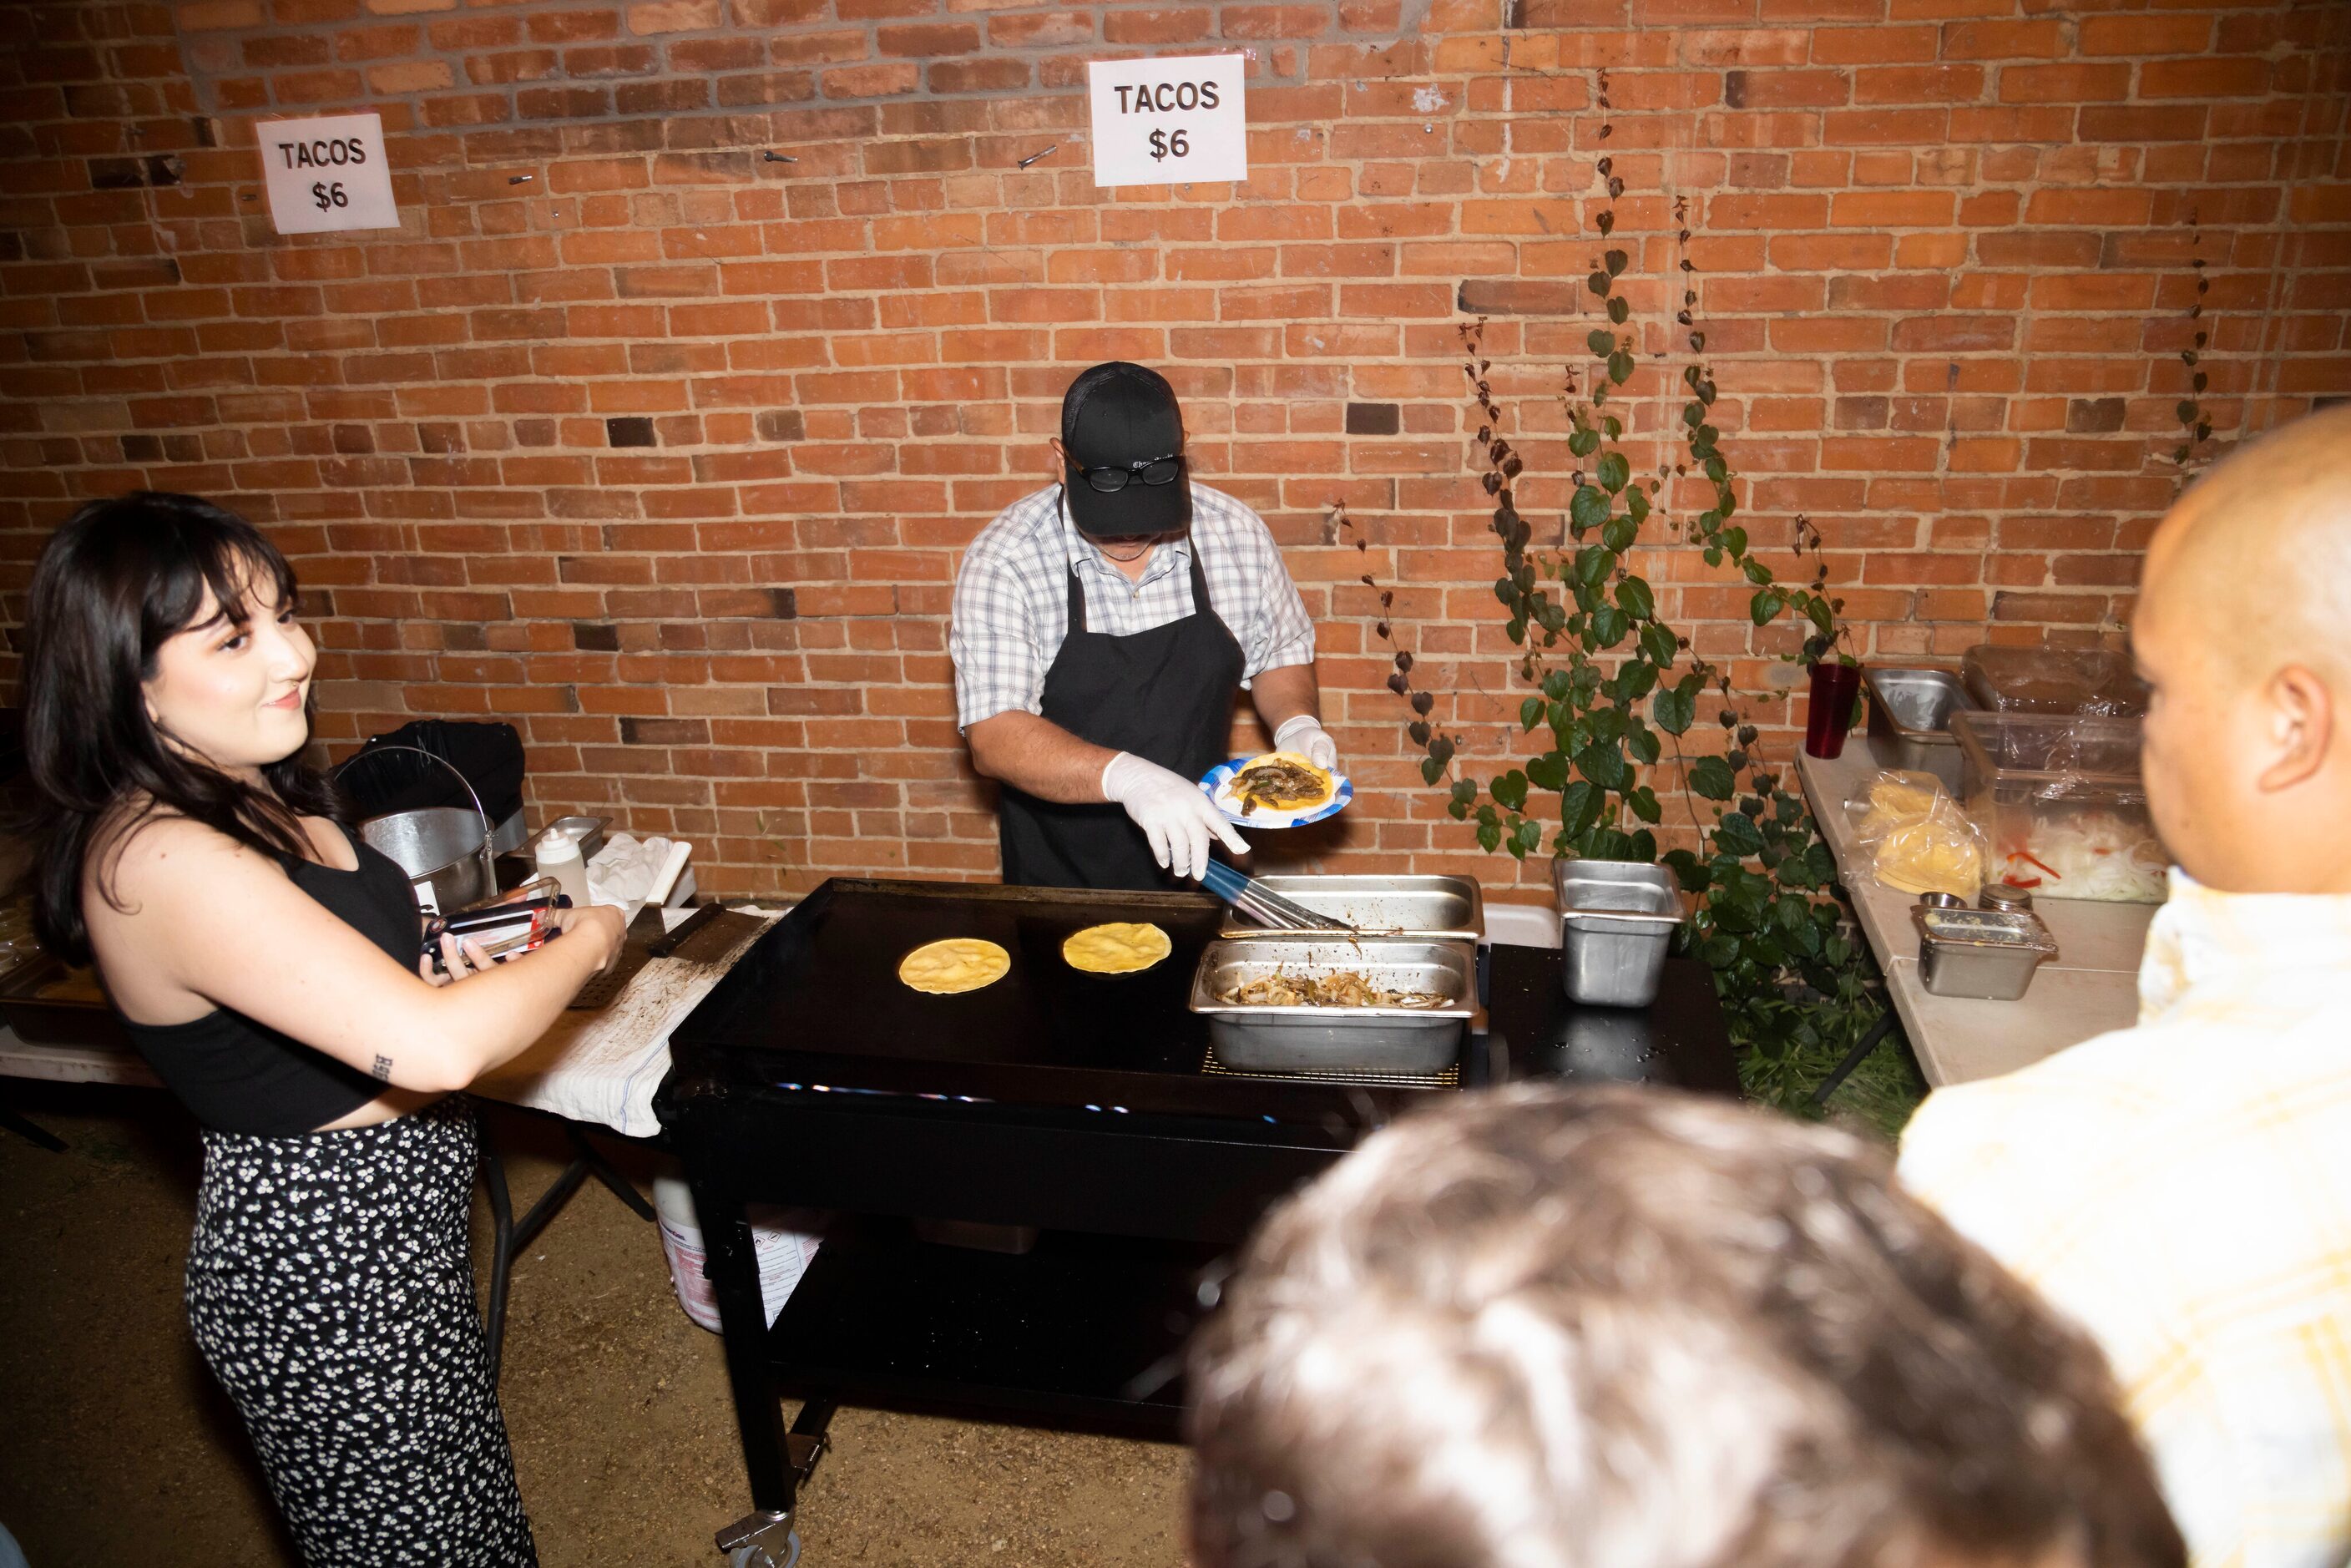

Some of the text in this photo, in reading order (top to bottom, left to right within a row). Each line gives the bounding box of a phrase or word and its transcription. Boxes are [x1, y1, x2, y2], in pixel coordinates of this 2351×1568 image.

[1115, 81, 1219, 114] TACOS
[277, 138, 366, 169] TACOS
[1150, 129, 1189, 162] $6
[312, 182, 348, 212] $6
